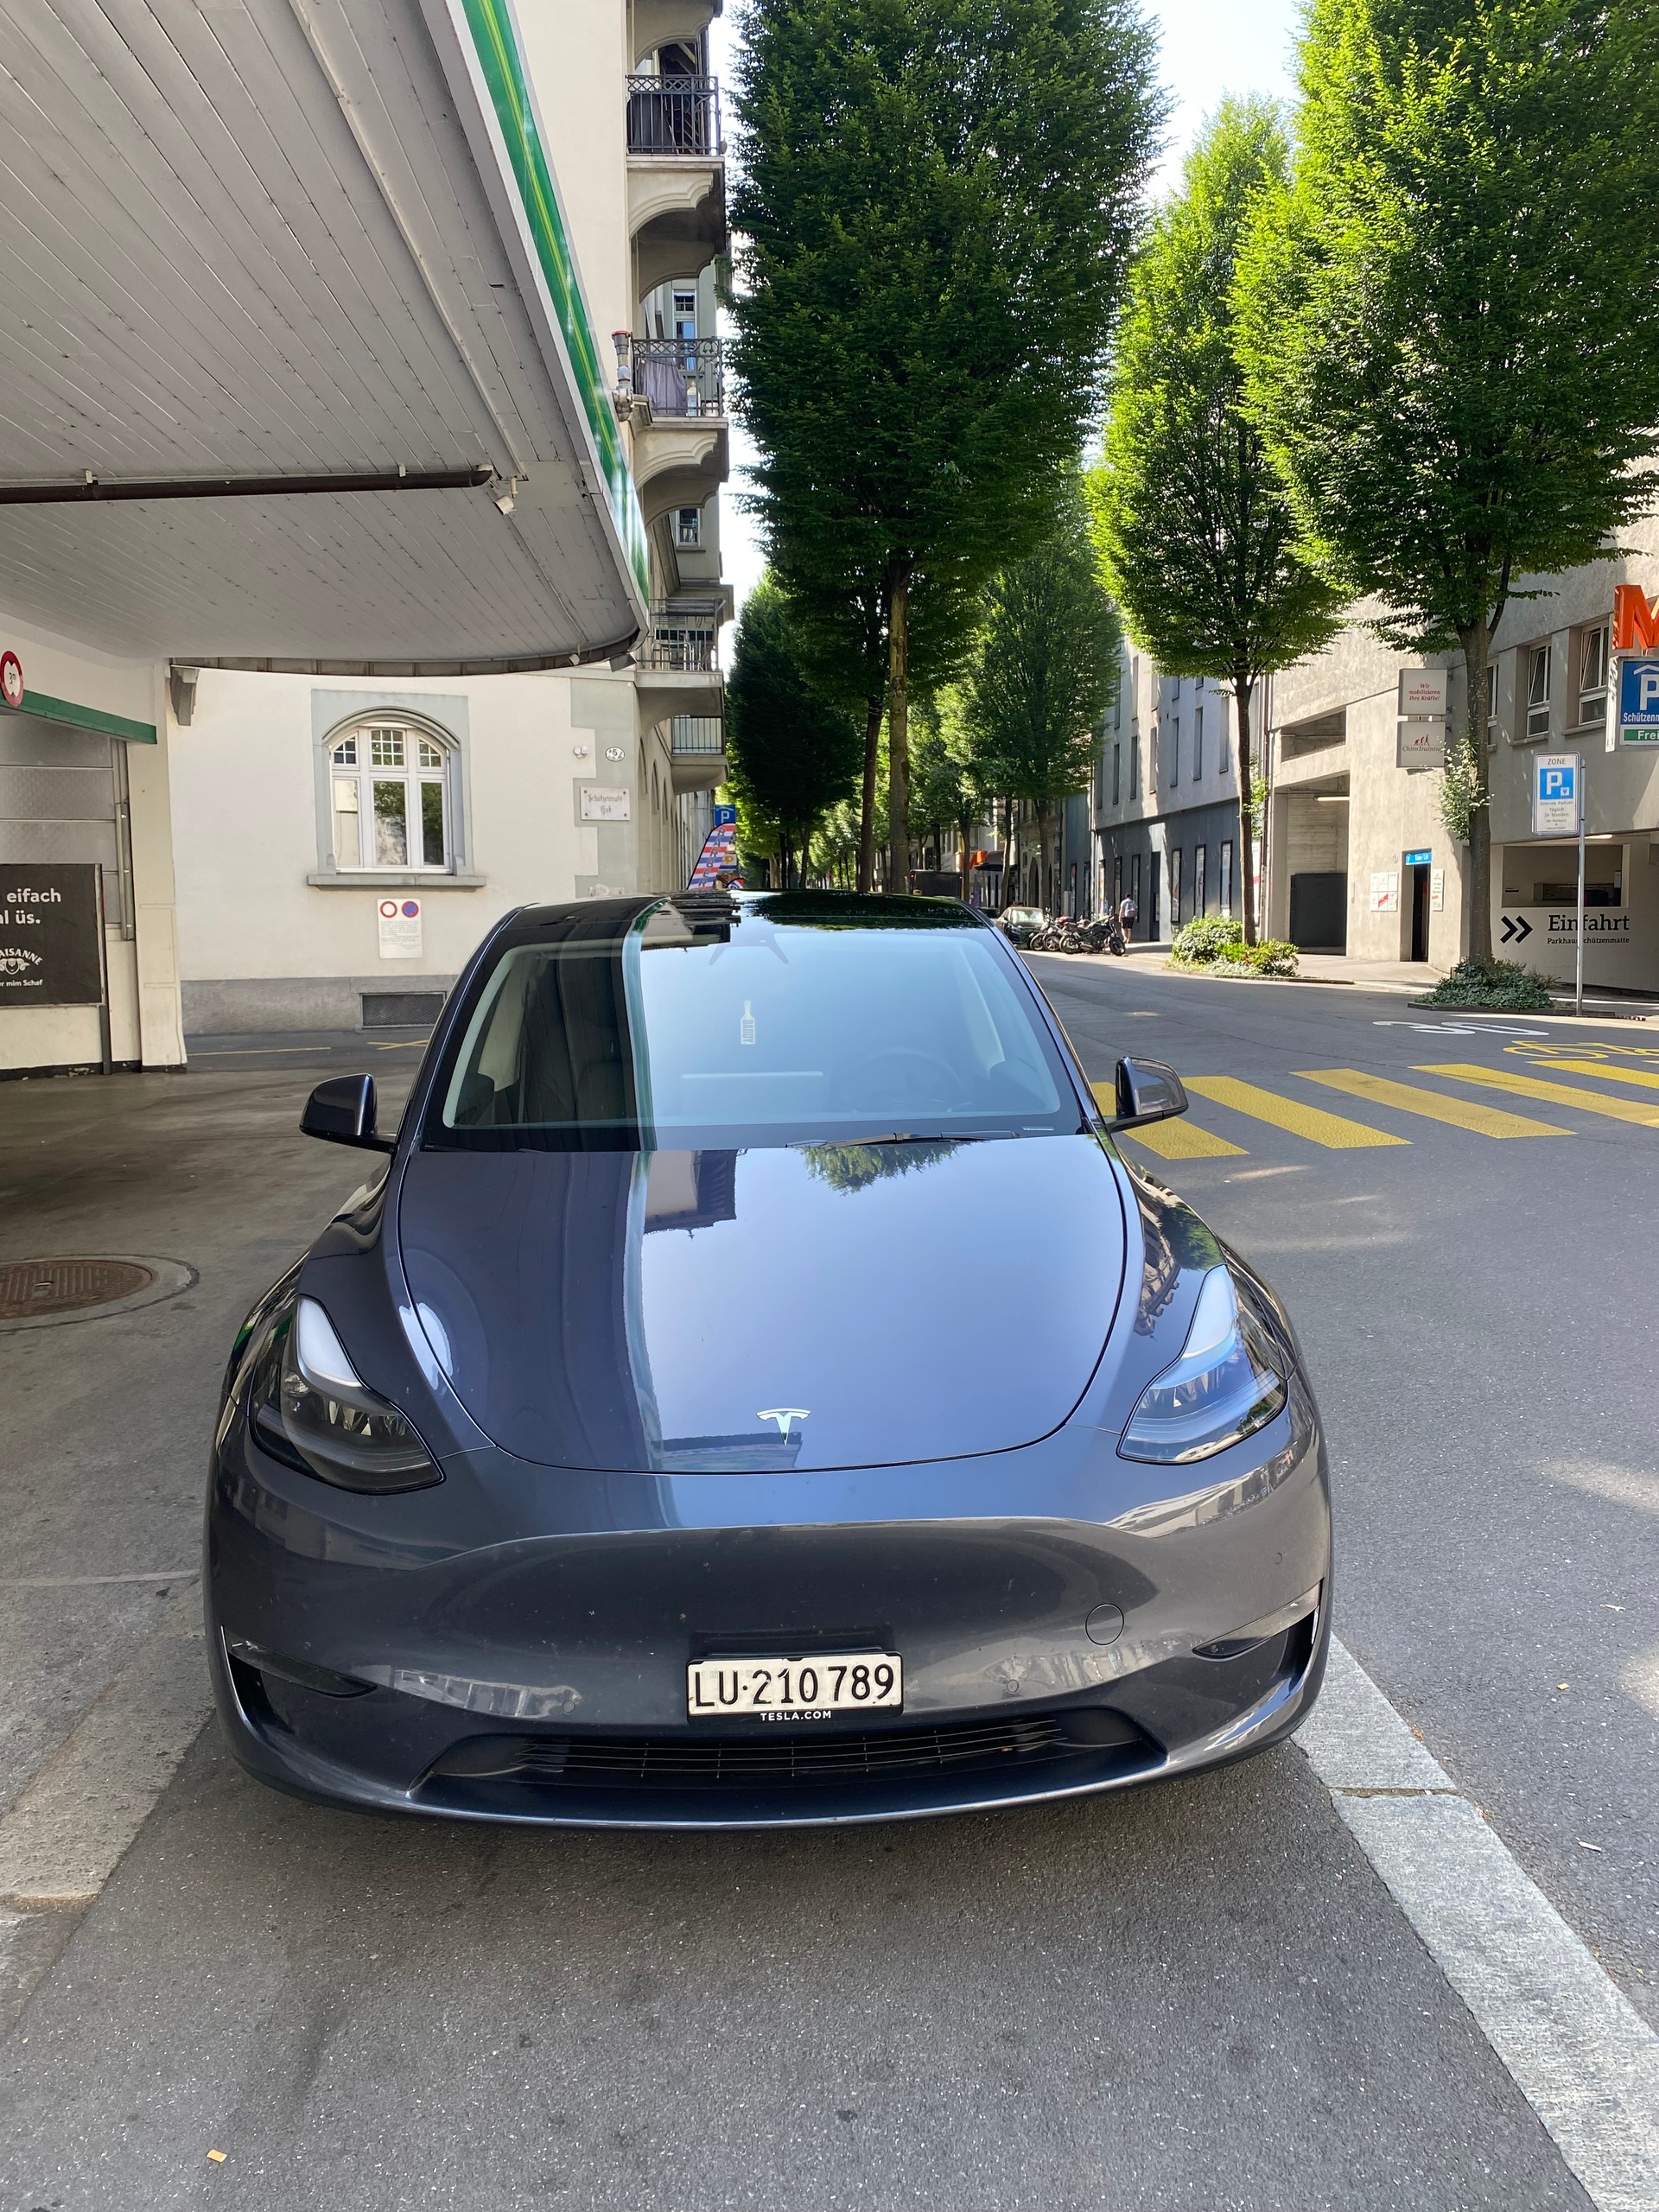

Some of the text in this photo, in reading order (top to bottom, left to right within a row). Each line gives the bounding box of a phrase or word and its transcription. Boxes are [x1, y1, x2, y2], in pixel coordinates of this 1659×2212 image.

[1546, 772, 1562, 795] P
[6, 887, 61, 903] eifach
[16, 910, 41, 925] üs.
[1548, 914, 1630, 931] Einfahrt
[1372, 1020, 1550, 1035] 30
[827, 1662, 895, 1702] 789
[760, 1710, 832, 1721] TESLA.COM
